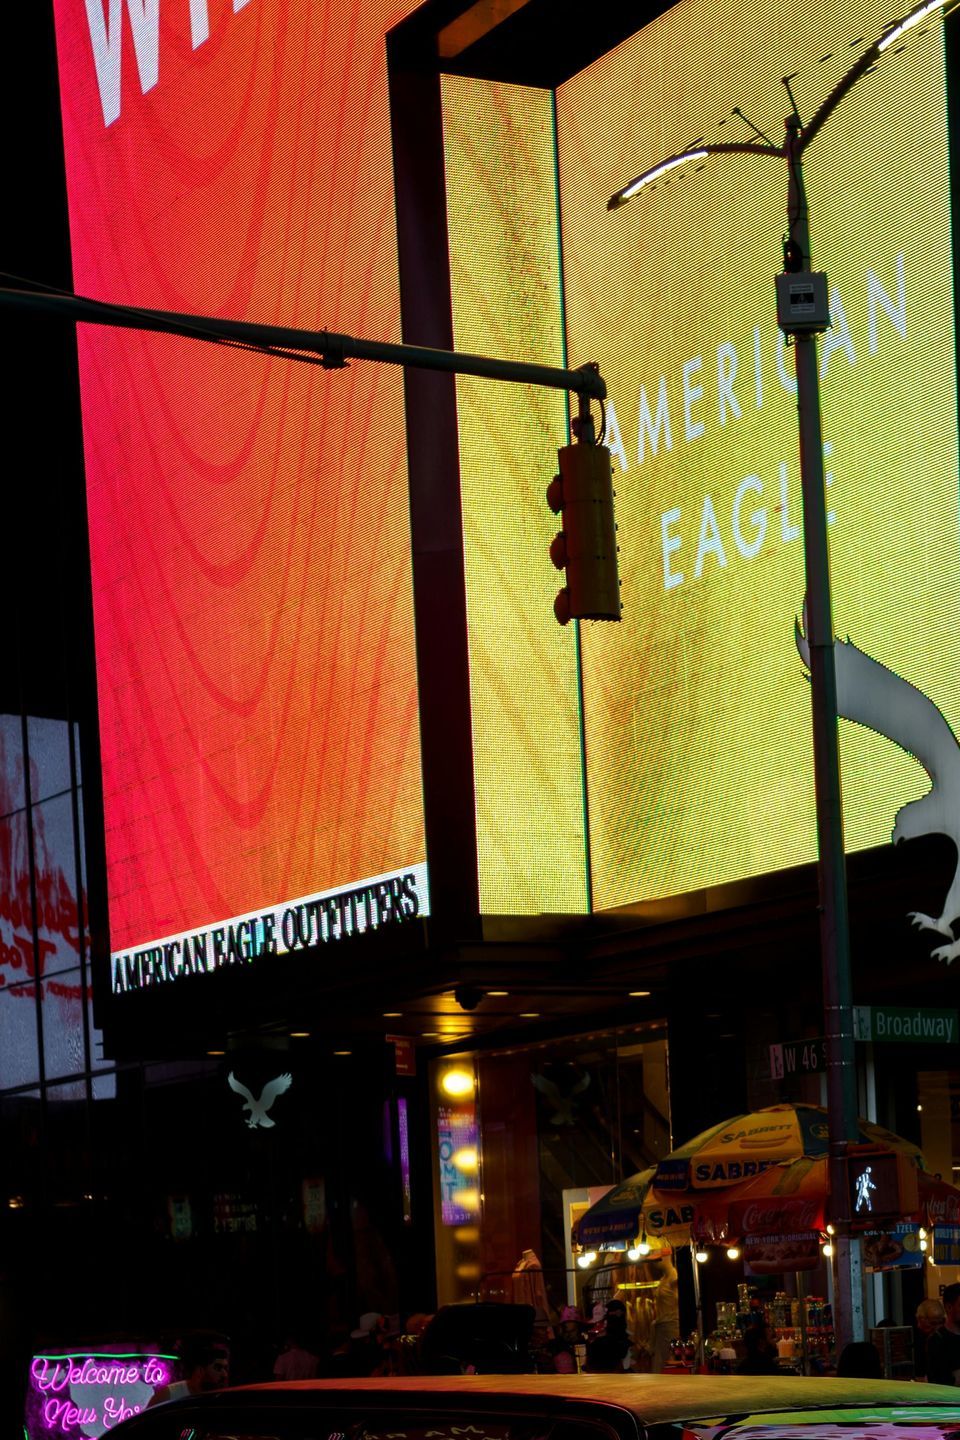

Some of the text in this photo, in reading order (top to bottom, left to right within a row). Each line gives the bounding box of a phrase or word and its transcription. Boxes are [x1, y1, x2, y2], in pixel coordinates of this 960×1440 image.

[112, 872, 420, 995] AMERICAN EAGLE OUTFITTERS
[876, 1012, 953, 1043] Broadway
[784, 1047, 796, 1073] W
[802, 1044, 818, 1071] 46
[696, 1159, 780, 1182] SABRE
[31, 1357, 166, 1392] Welcome to
[44, 1398, 98, 1432] New
